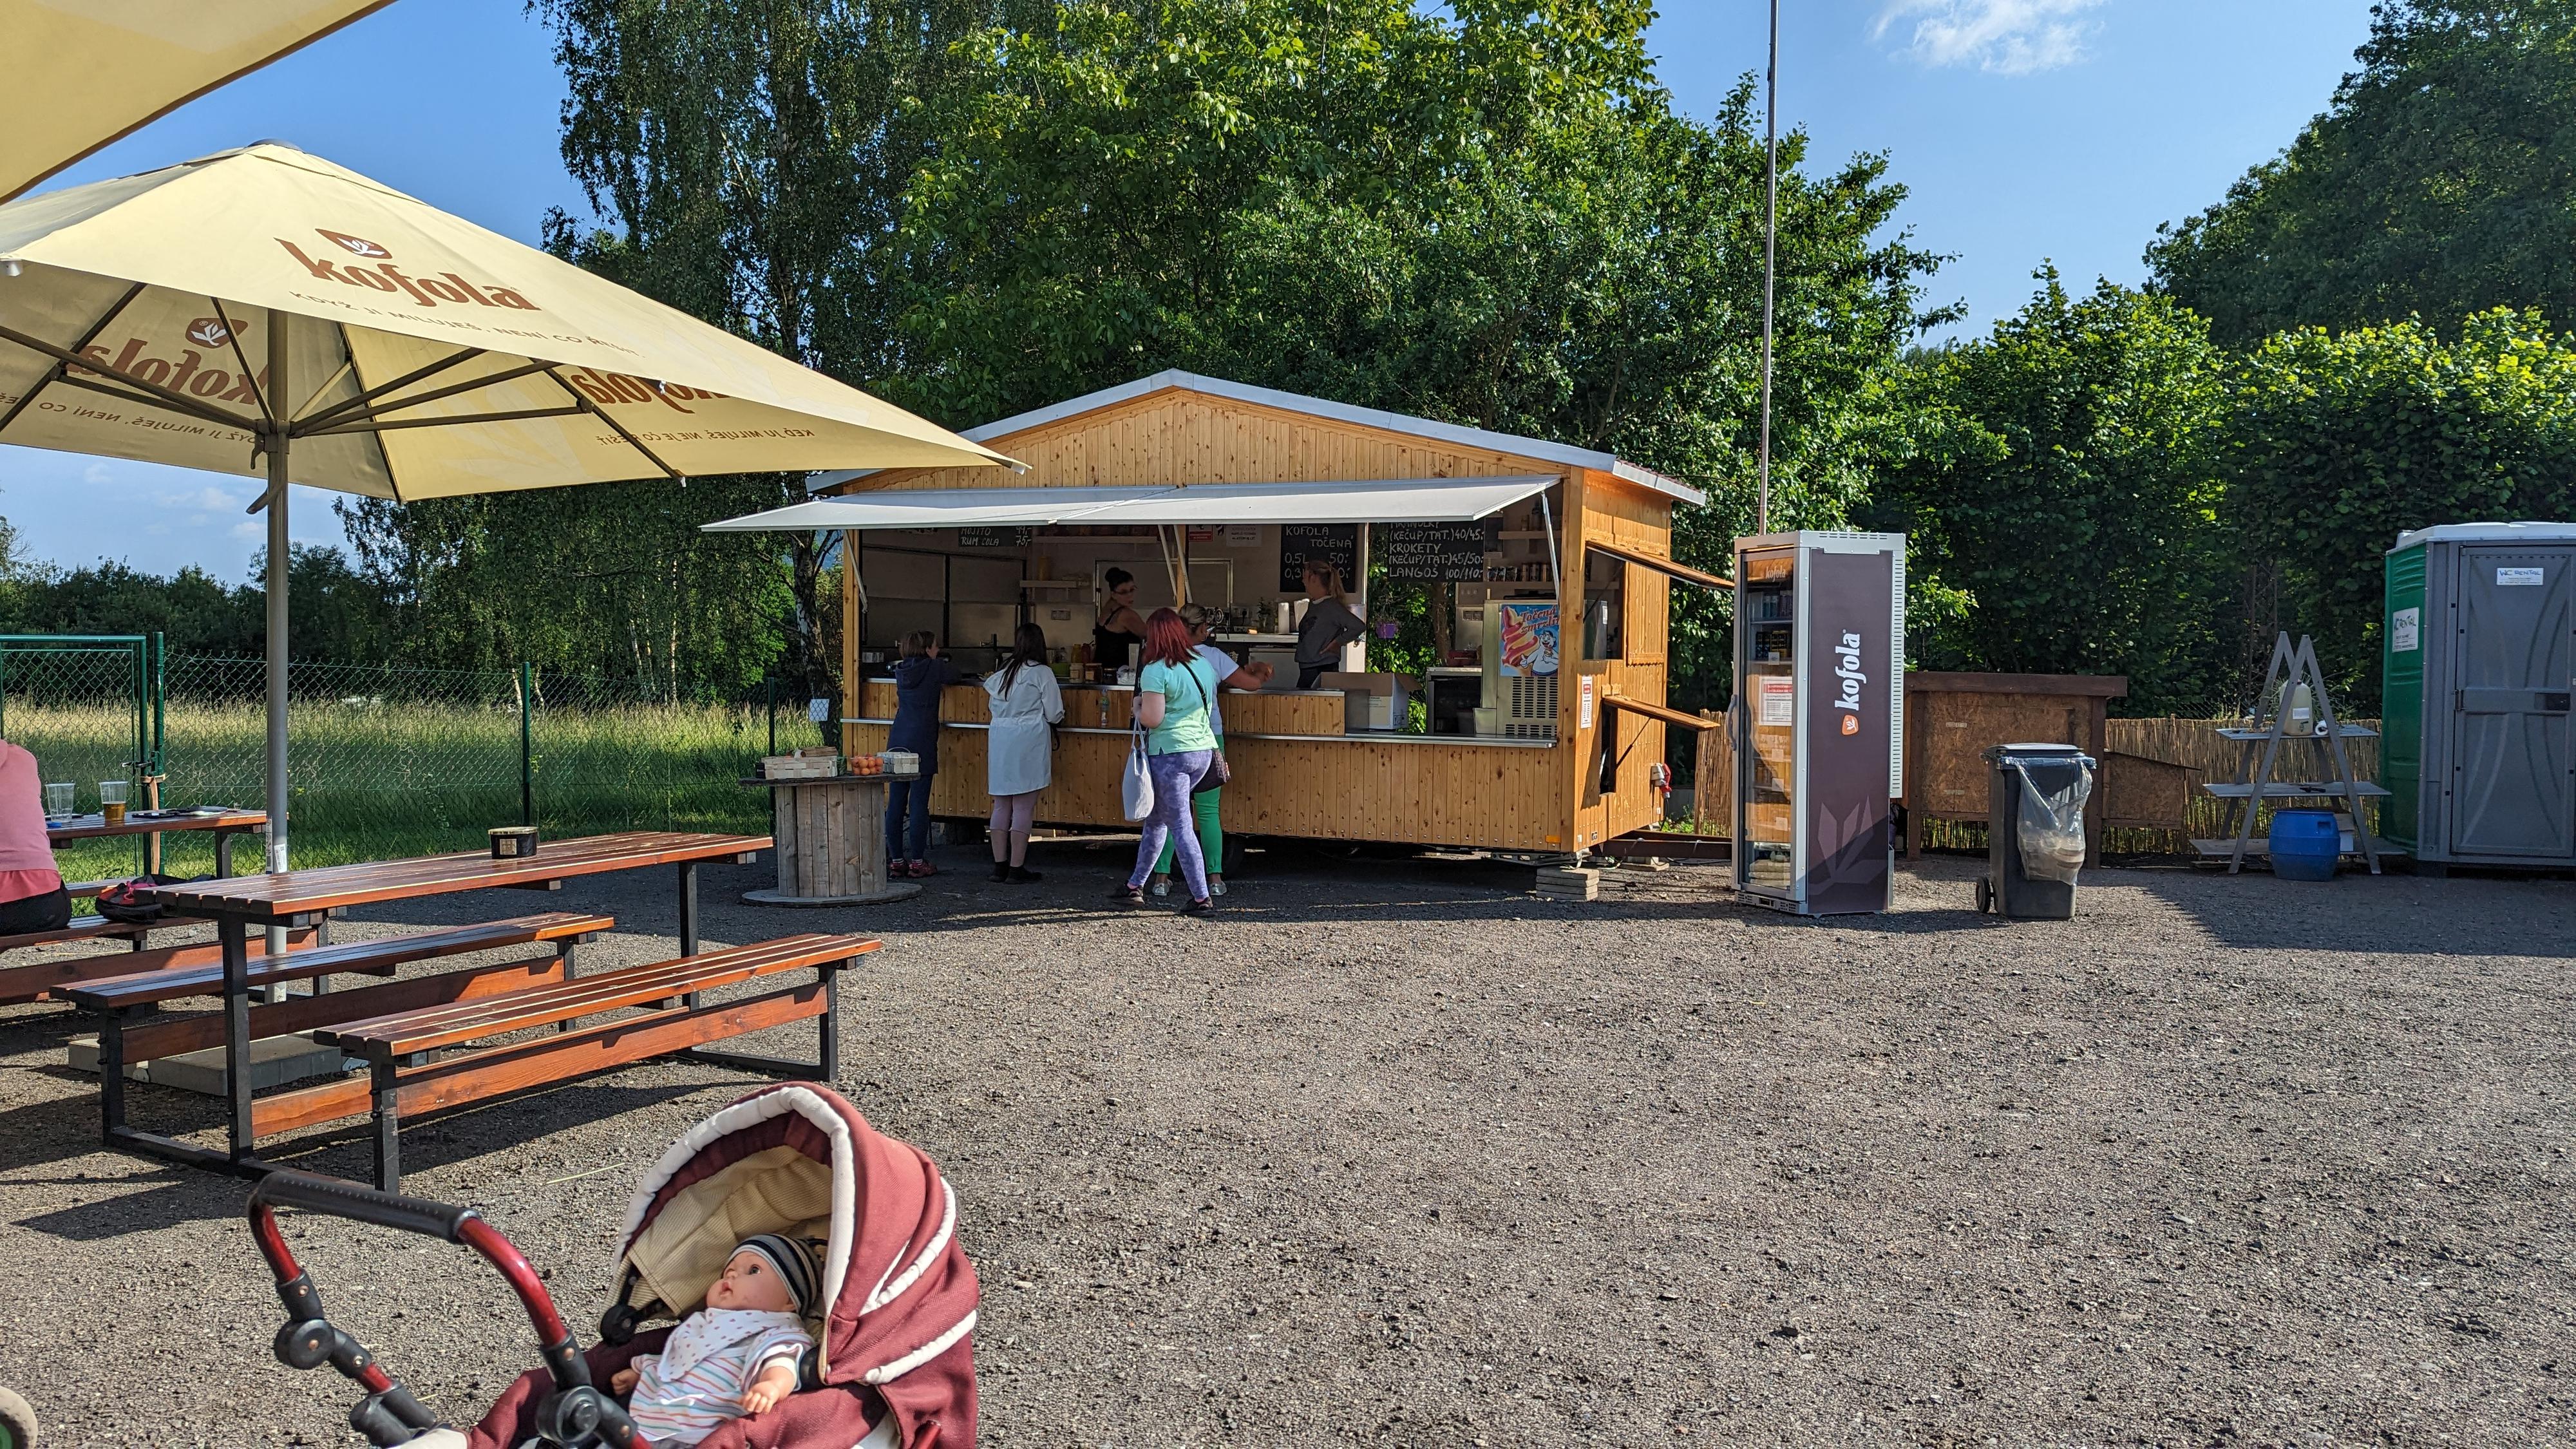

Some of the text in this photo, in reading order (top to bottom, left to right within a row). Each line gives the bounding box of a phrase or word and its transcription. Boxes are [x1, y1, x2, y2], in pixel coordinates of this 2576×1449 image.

[273, 238, 542, 310] kofola
[553, 335, 583, 343] CO
[1286, 526, 1329, 536] KOFOLA
[961, 536, 978, 545] RUM
[1309, 535, 1354, 549] TOČENÁ
[1390, 543, 1441, 554] KROKETY
[1390, 562, 1439, 578] LANGOŠ
[1765, 565, 1786, 582] kofola
[1835, 633, 1866, 711] kofola
